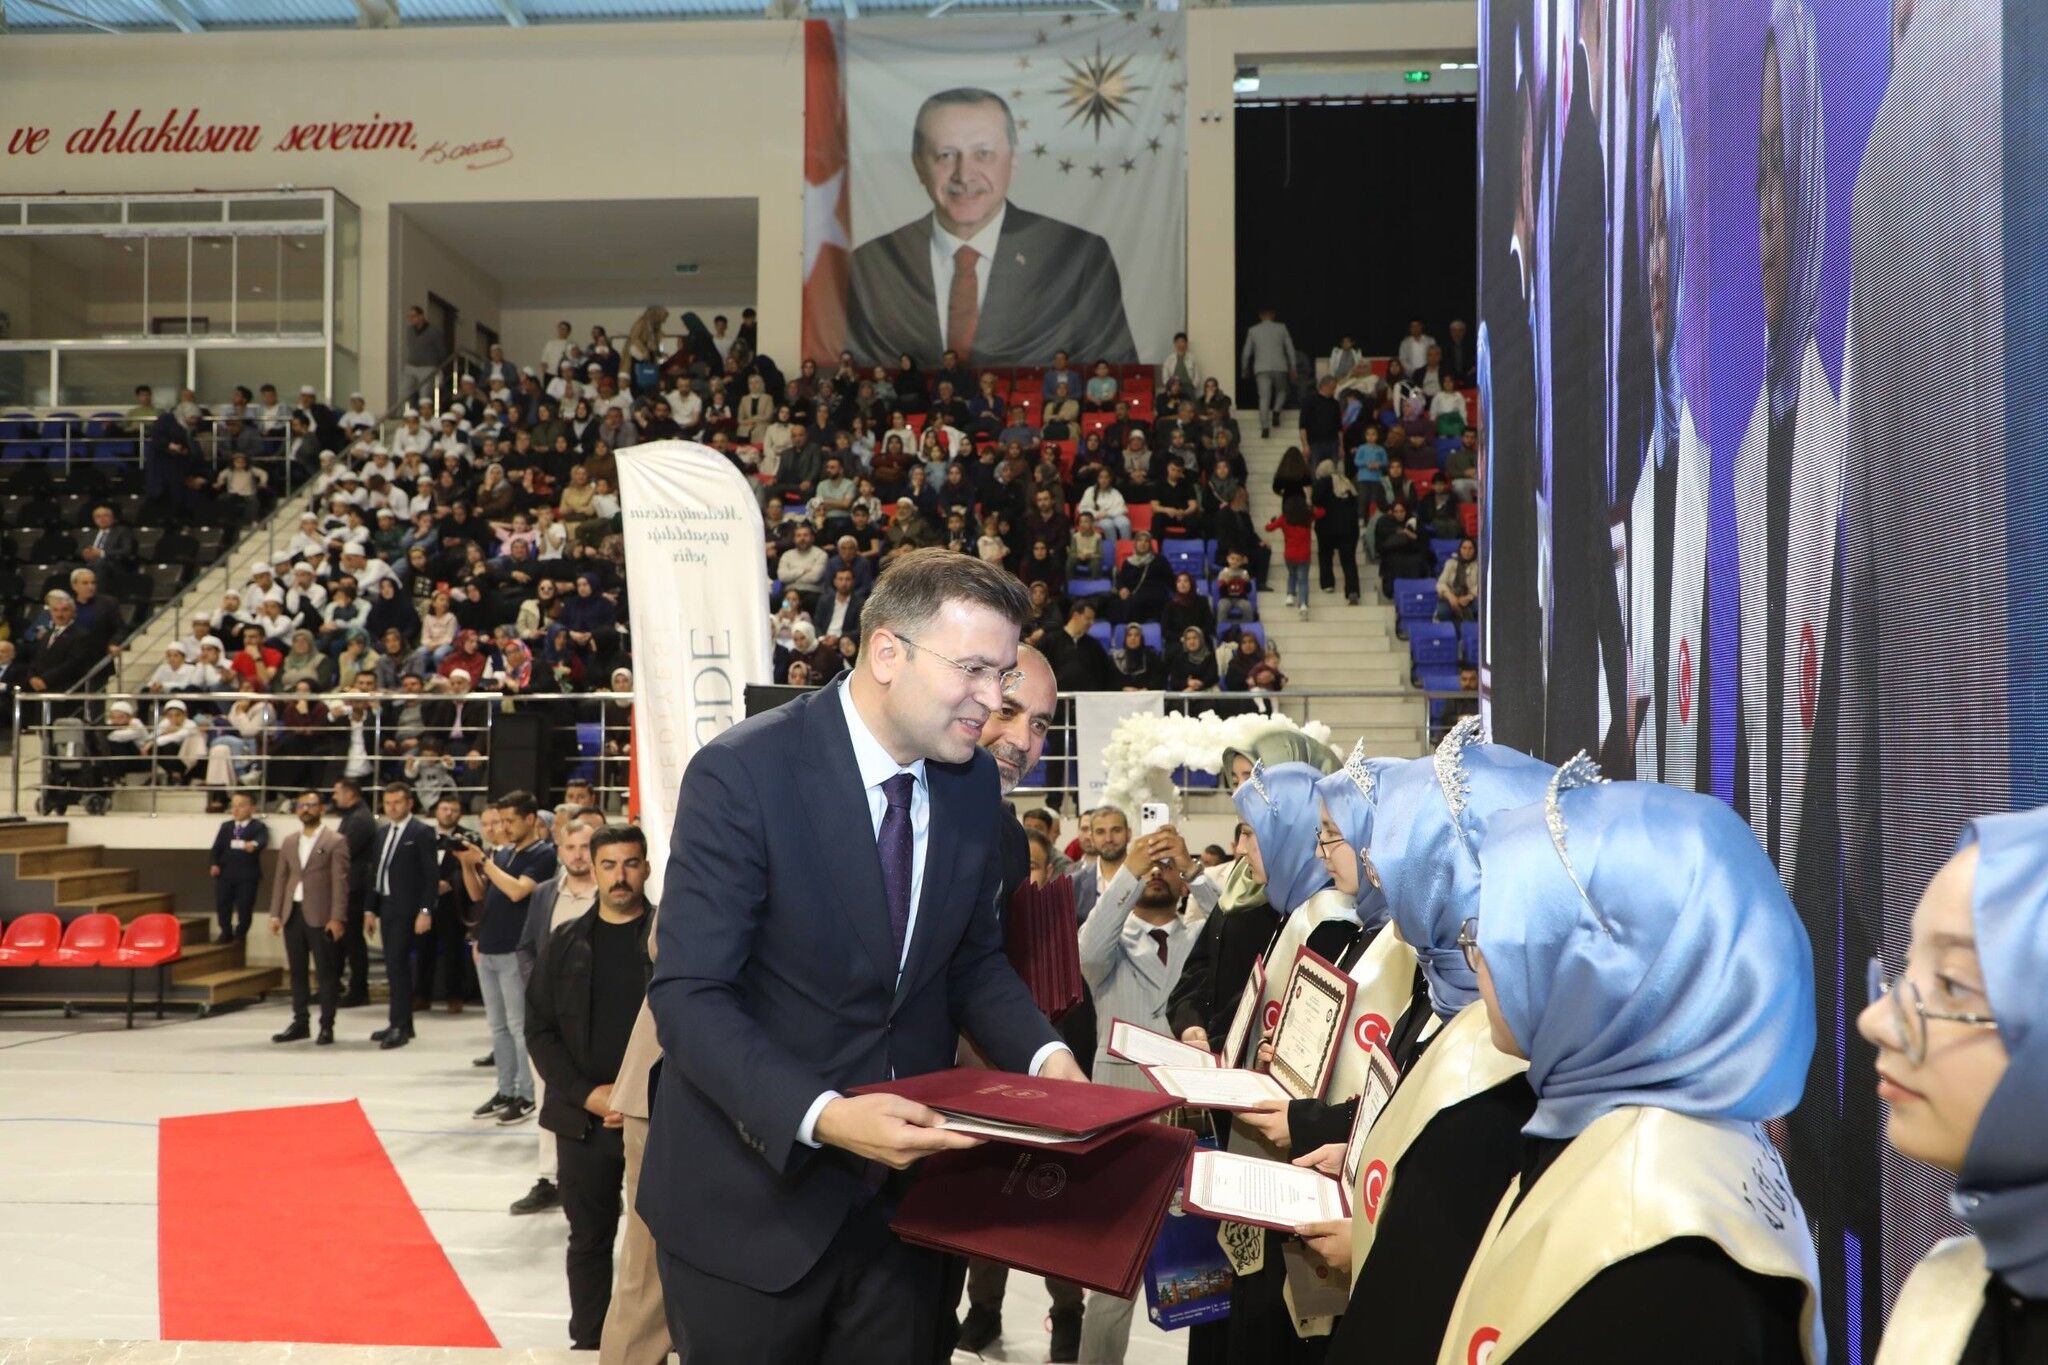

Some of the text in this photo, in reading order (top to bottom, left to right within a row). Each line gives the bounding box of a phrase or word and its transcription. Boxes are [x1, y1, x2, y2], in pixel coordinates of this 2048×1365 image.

[8, 108, 419, 154] ve ahlaklısını severim.
